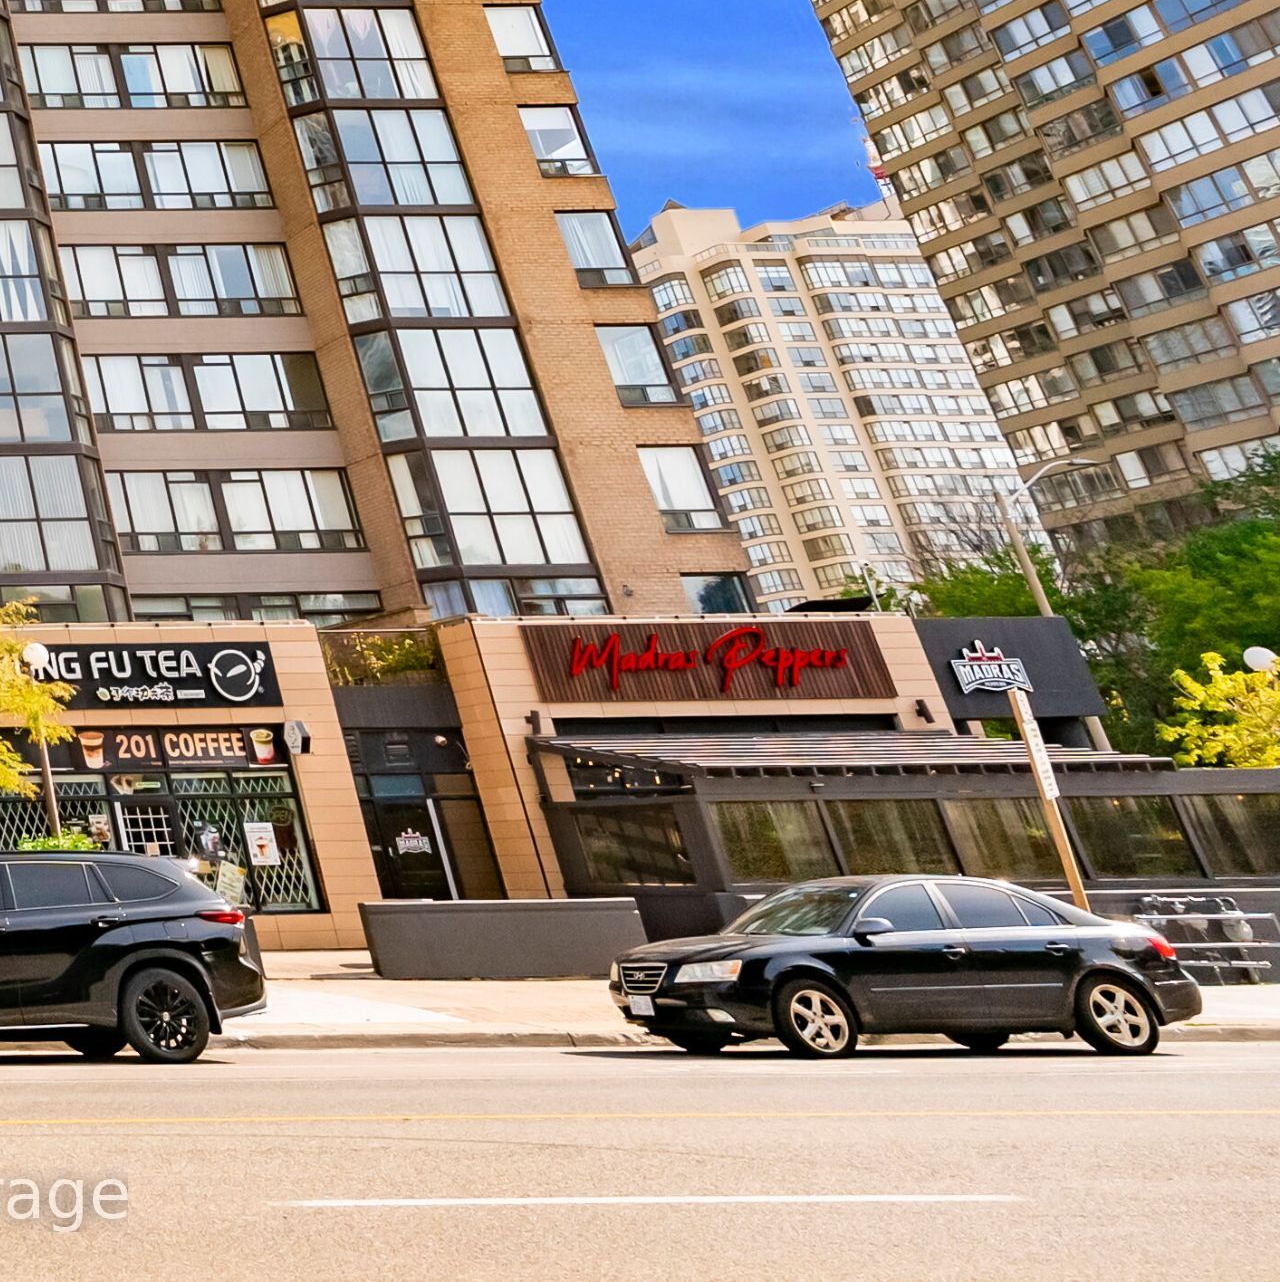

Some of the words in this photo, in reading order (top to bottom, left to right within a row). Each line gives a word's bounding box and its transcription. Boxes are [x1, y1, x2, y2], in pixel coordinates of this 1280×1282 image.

[89, 650, 132, 680] FU
[135, 649, 203, 679] TEA
[570, 632, 698, 691] Madras
[704, 625, 848, 693] Peppers
[957, 663, 1025, 684] MADRAS
[115, 733, 158, 759] 201
[163, 732, 247, 758] COFFEE
